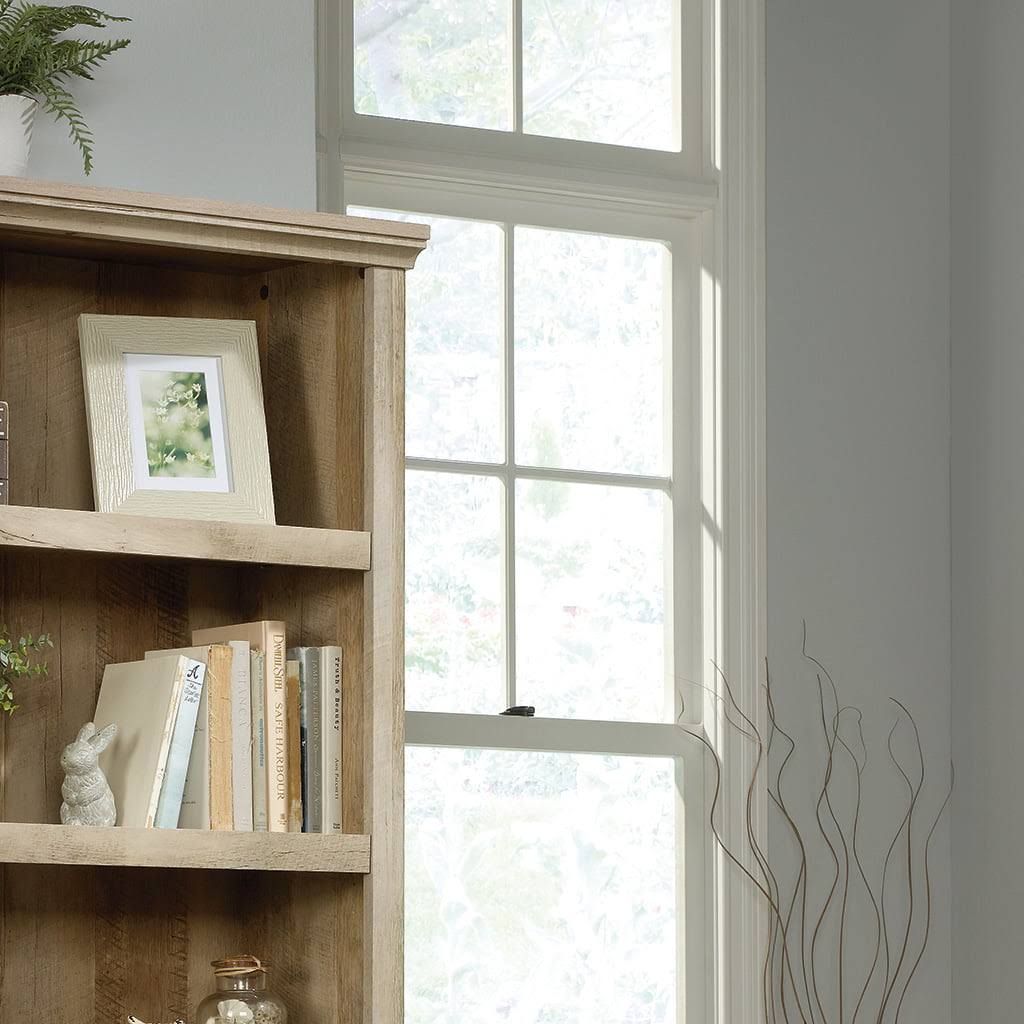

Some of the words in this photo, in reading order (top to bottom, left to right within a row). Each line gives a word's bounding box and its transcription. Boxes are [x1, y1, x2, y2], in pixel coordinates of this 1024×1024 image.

[187, 664, 200, 679] A
[275, 702, 284, 734] SAFE
[276, 737, 285, 800] HARBOUR
